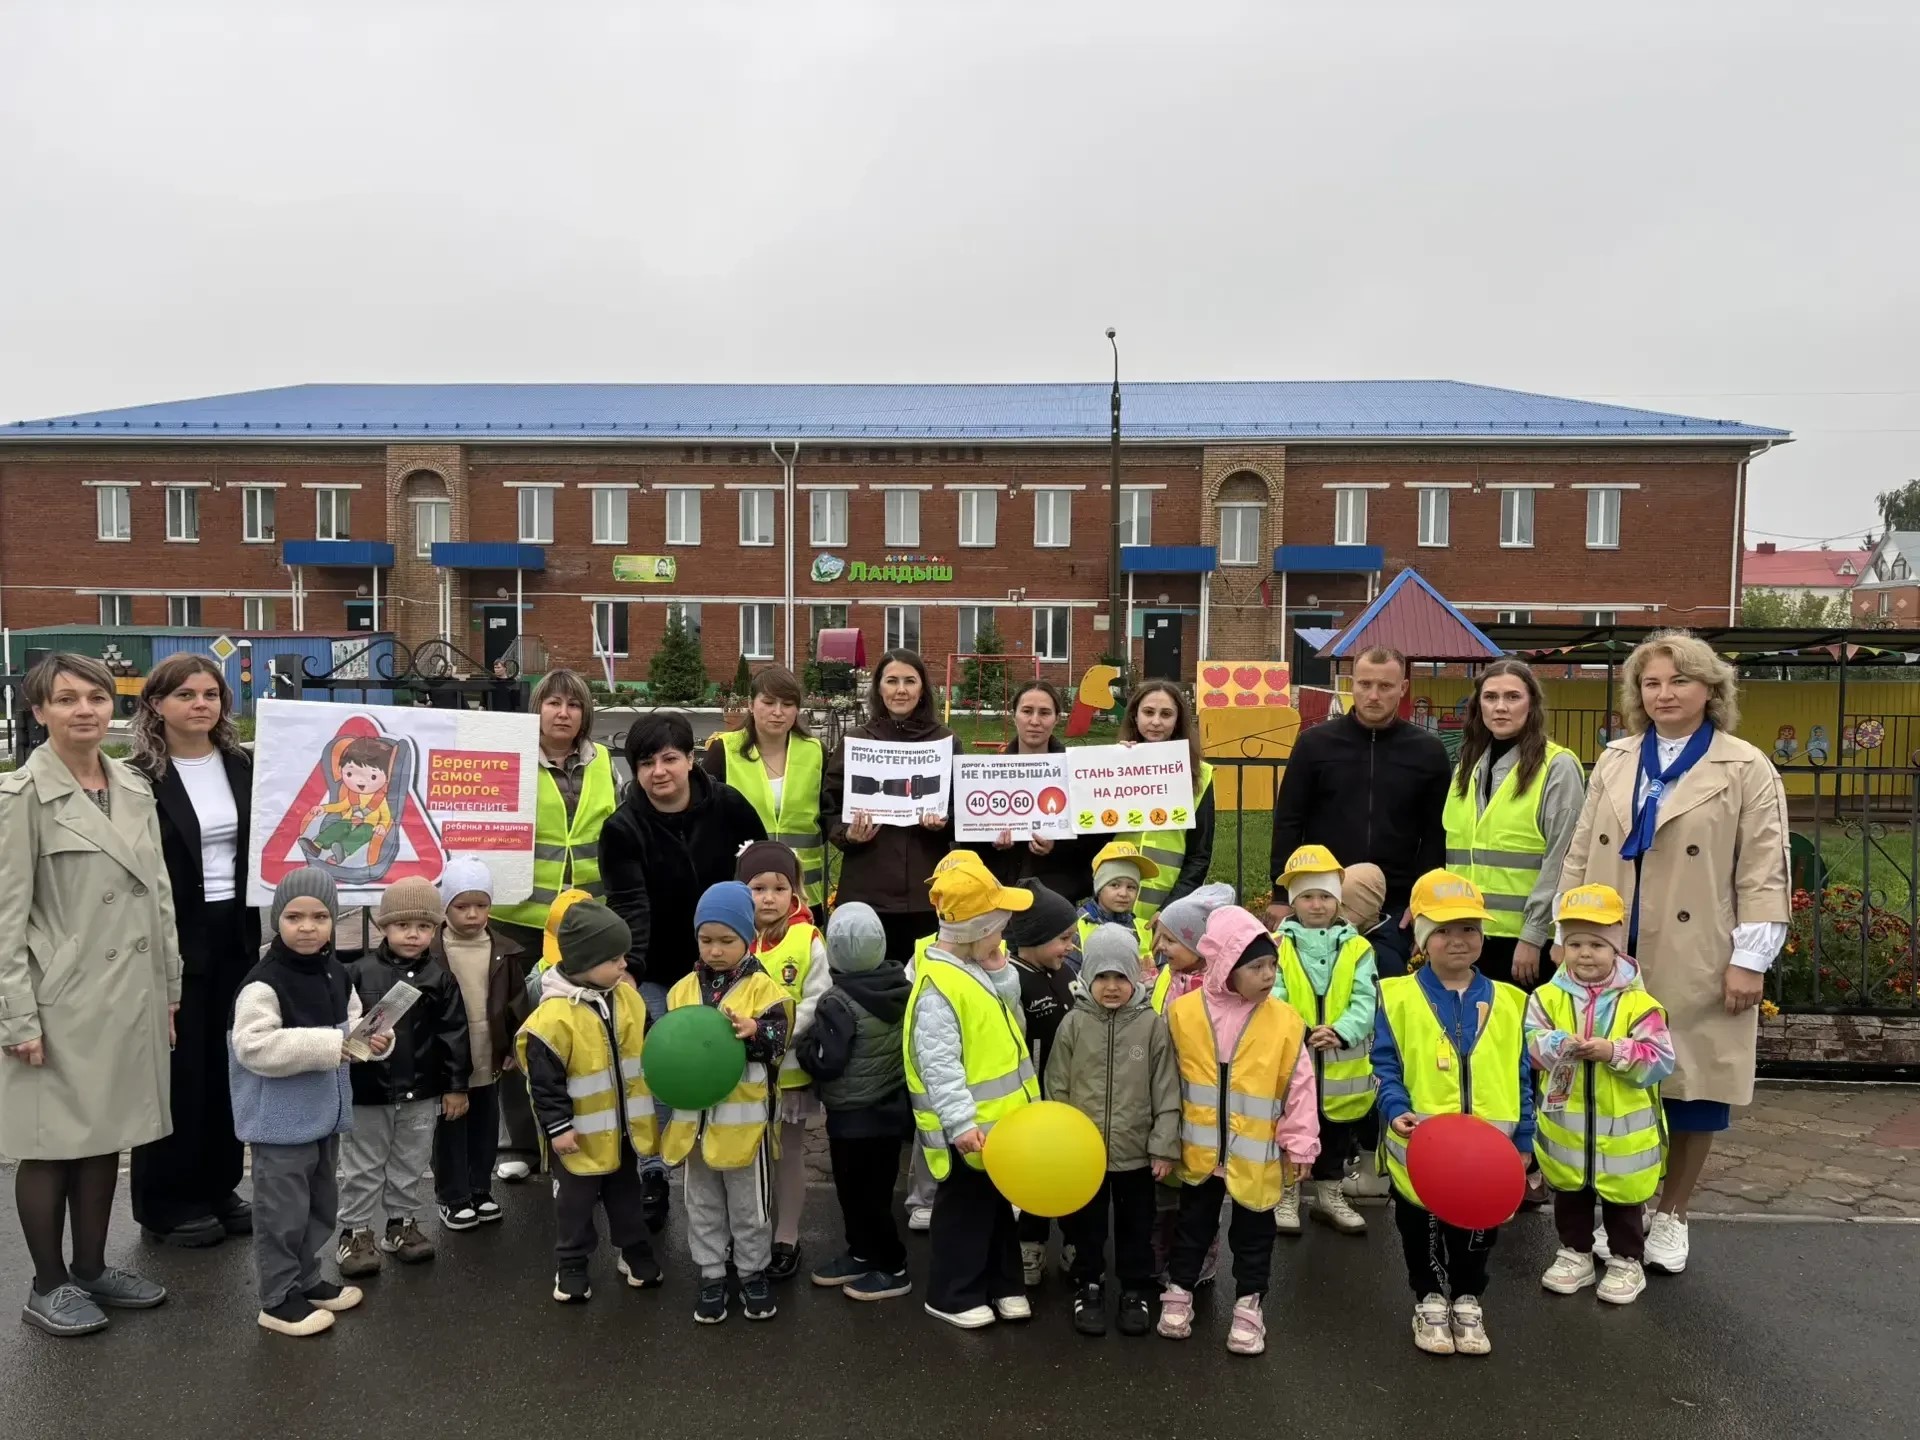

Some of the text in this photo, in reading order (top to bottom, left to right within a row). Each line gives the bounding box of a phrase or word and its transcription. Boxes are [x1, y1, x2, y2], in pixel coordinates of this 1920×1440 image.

[432, 755, 509, 771] Берегите
[851, 752, 941, 765] ПРИСТЕГНИСЬ
[961, 766, 1062, 779] НЕ ПРЕВЫШАЙ
[1074, 760, 1184, 779] СТАНЬ ЗАМЕТНЕЙ
[431, 771, 482, 782] самое
[430, 784, 499, 797] дорогое
[1093, 783, 1168, 799] НА ДОРОГЕ!
[430, 801, 508, 811] ПРИСТЕГНИТЕ
[970, 797, 985, 807] 40
[992, 798, 1006, 808] 50
[1014, 797, 1029, 808] 60
[445, 823, 482, 831] ребенка
[493, 824, 529, 832] машине
